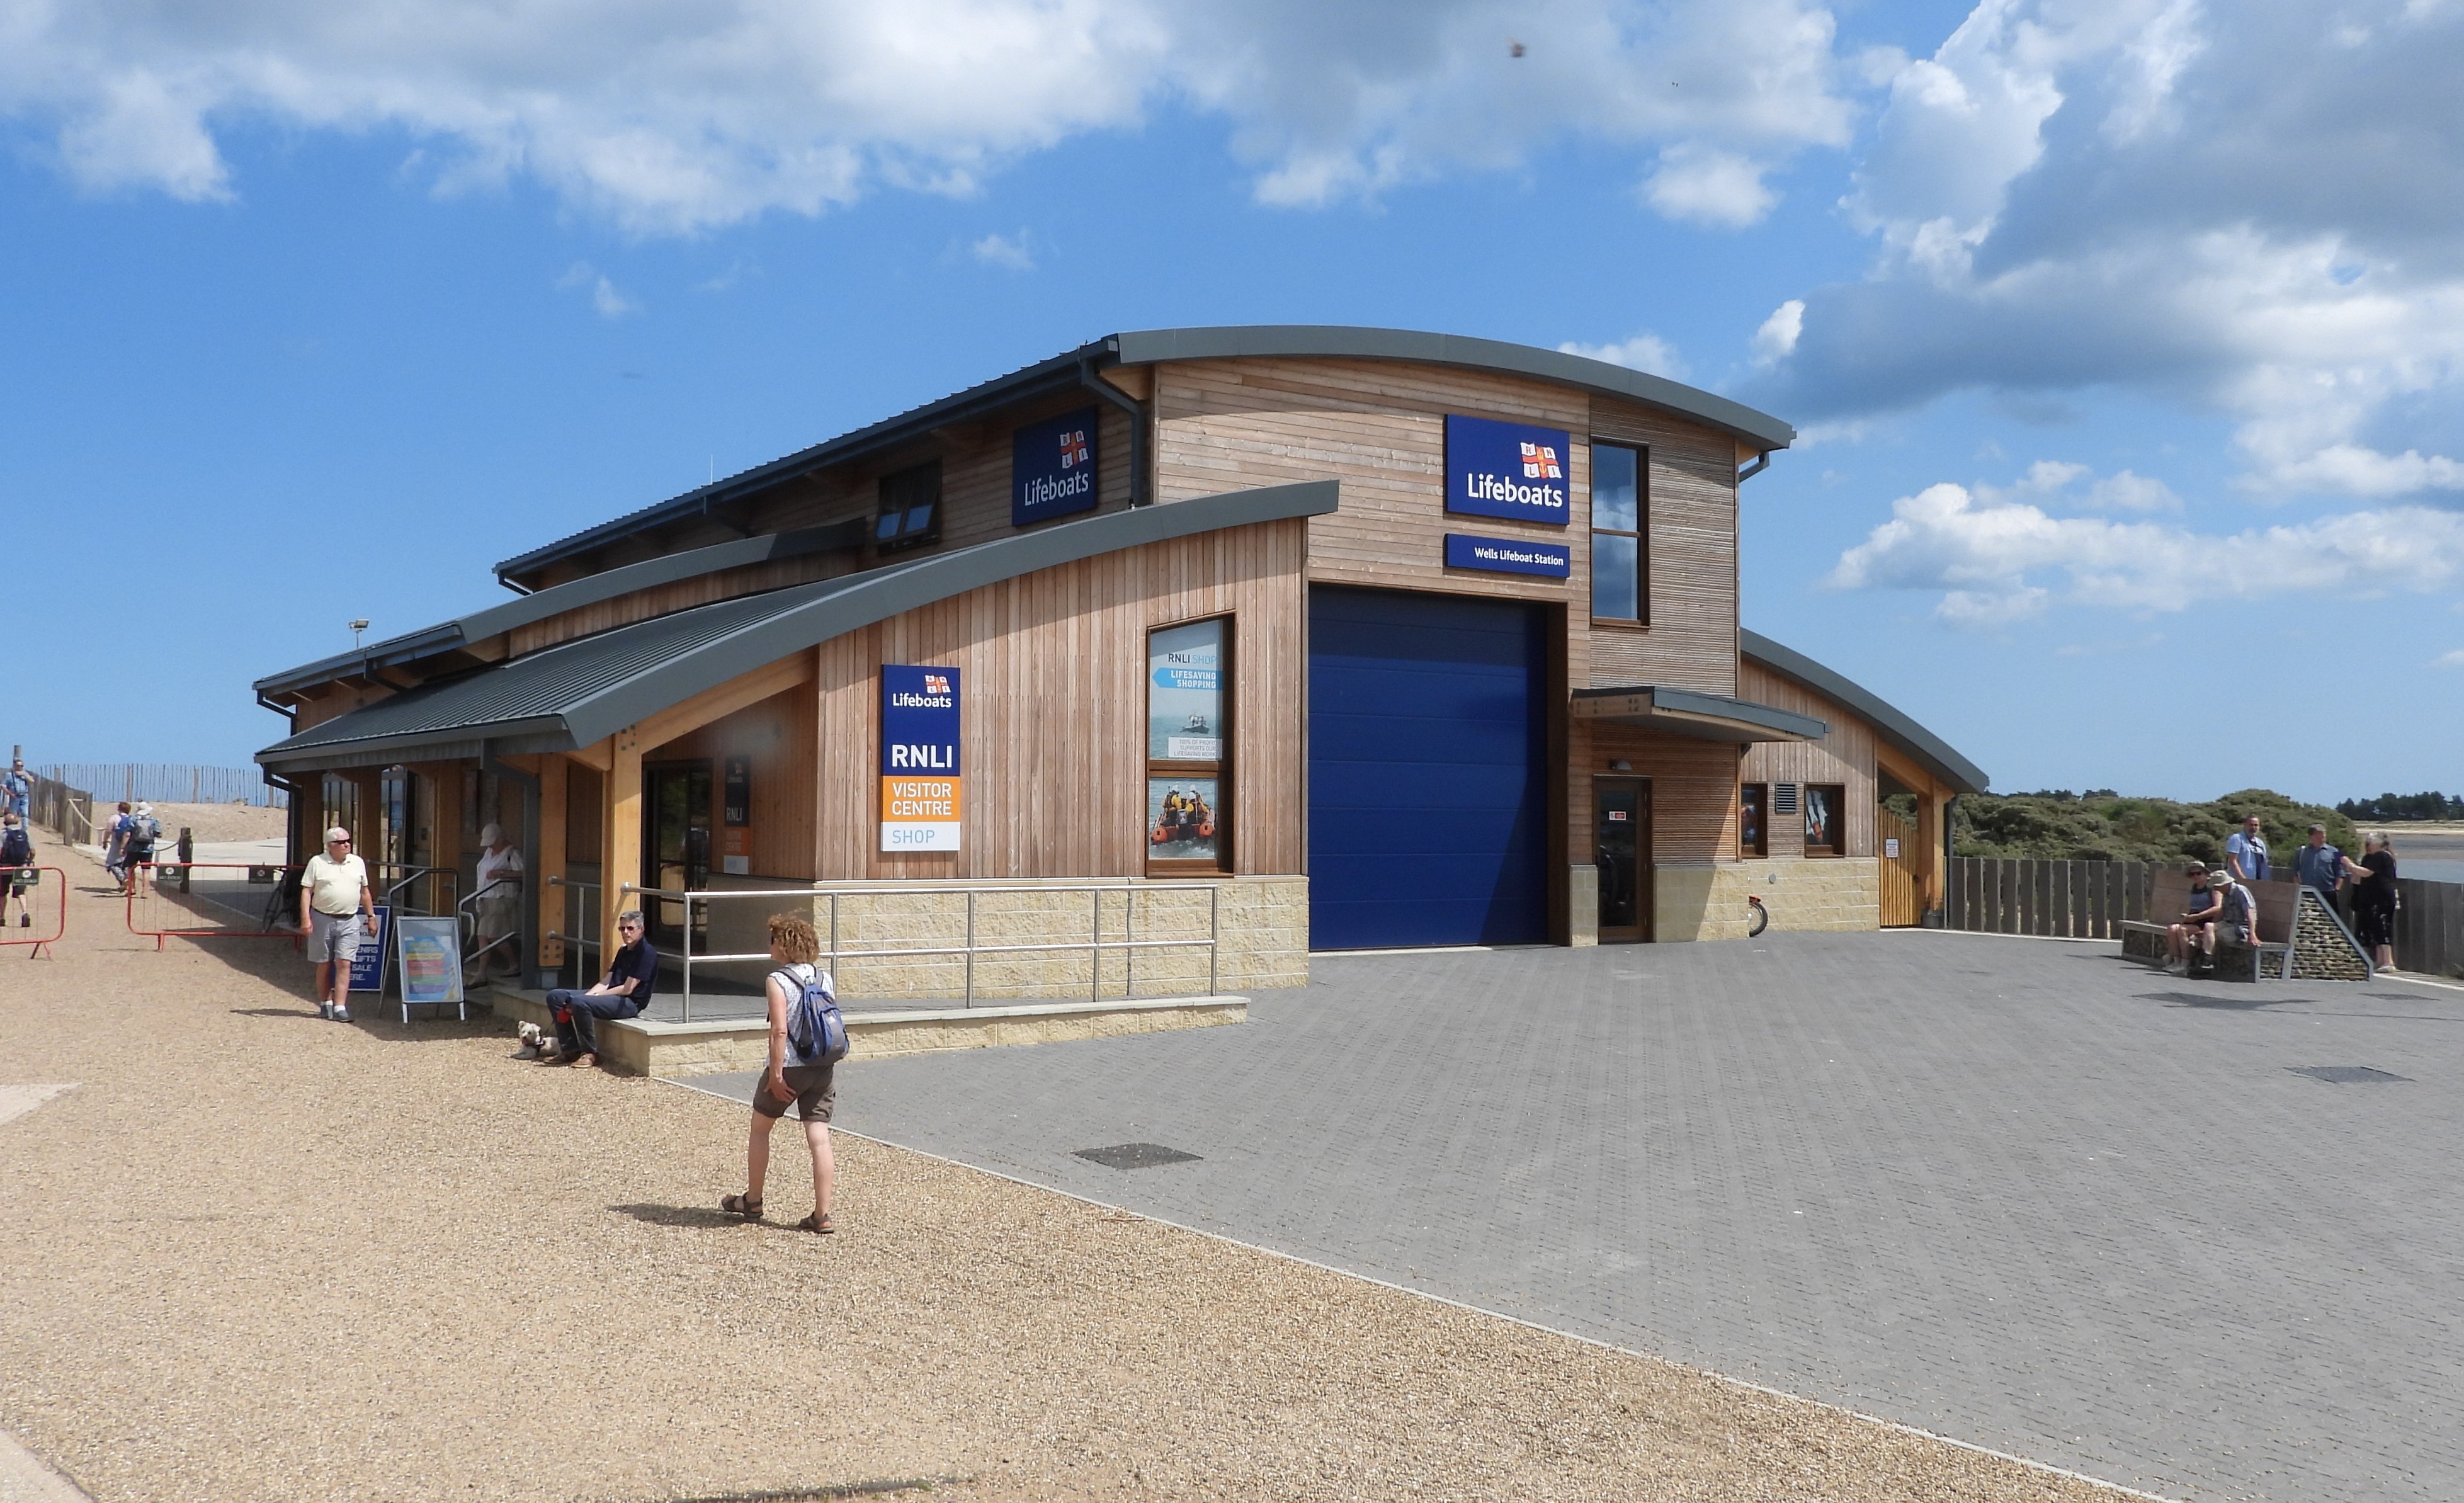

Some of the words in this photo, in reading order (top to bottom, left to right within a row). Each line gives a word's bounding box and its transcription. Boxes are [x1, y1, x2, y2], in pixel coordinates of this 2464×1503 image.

[1025, 471, 1089, 506] Lifeboats
[1468, 473, 1562, 508] Lifeboats
[1474, 547, 1498, 560] Wells
[1499, 550, 1533, 563] Lifeboat
[1534, 553, 1564, 566] Station
[1168, 653, 1190, 663] RNLI
[1192, 655, 1217, 664] SHOP
[1171, 670, 1216, 680] LIFESAVING
[1176, 679, 1216, 688] SHOPPING
[892, 693, 951, 708] Lifeboats
[892, 744, 952, 768] RNLI
[892, 783, 951, 797] VISITOR
[726, 807, 742, 822] RNLI
[892, 801, 951, 815] CENTRE
[892, 830, 934, 844] SHOP
